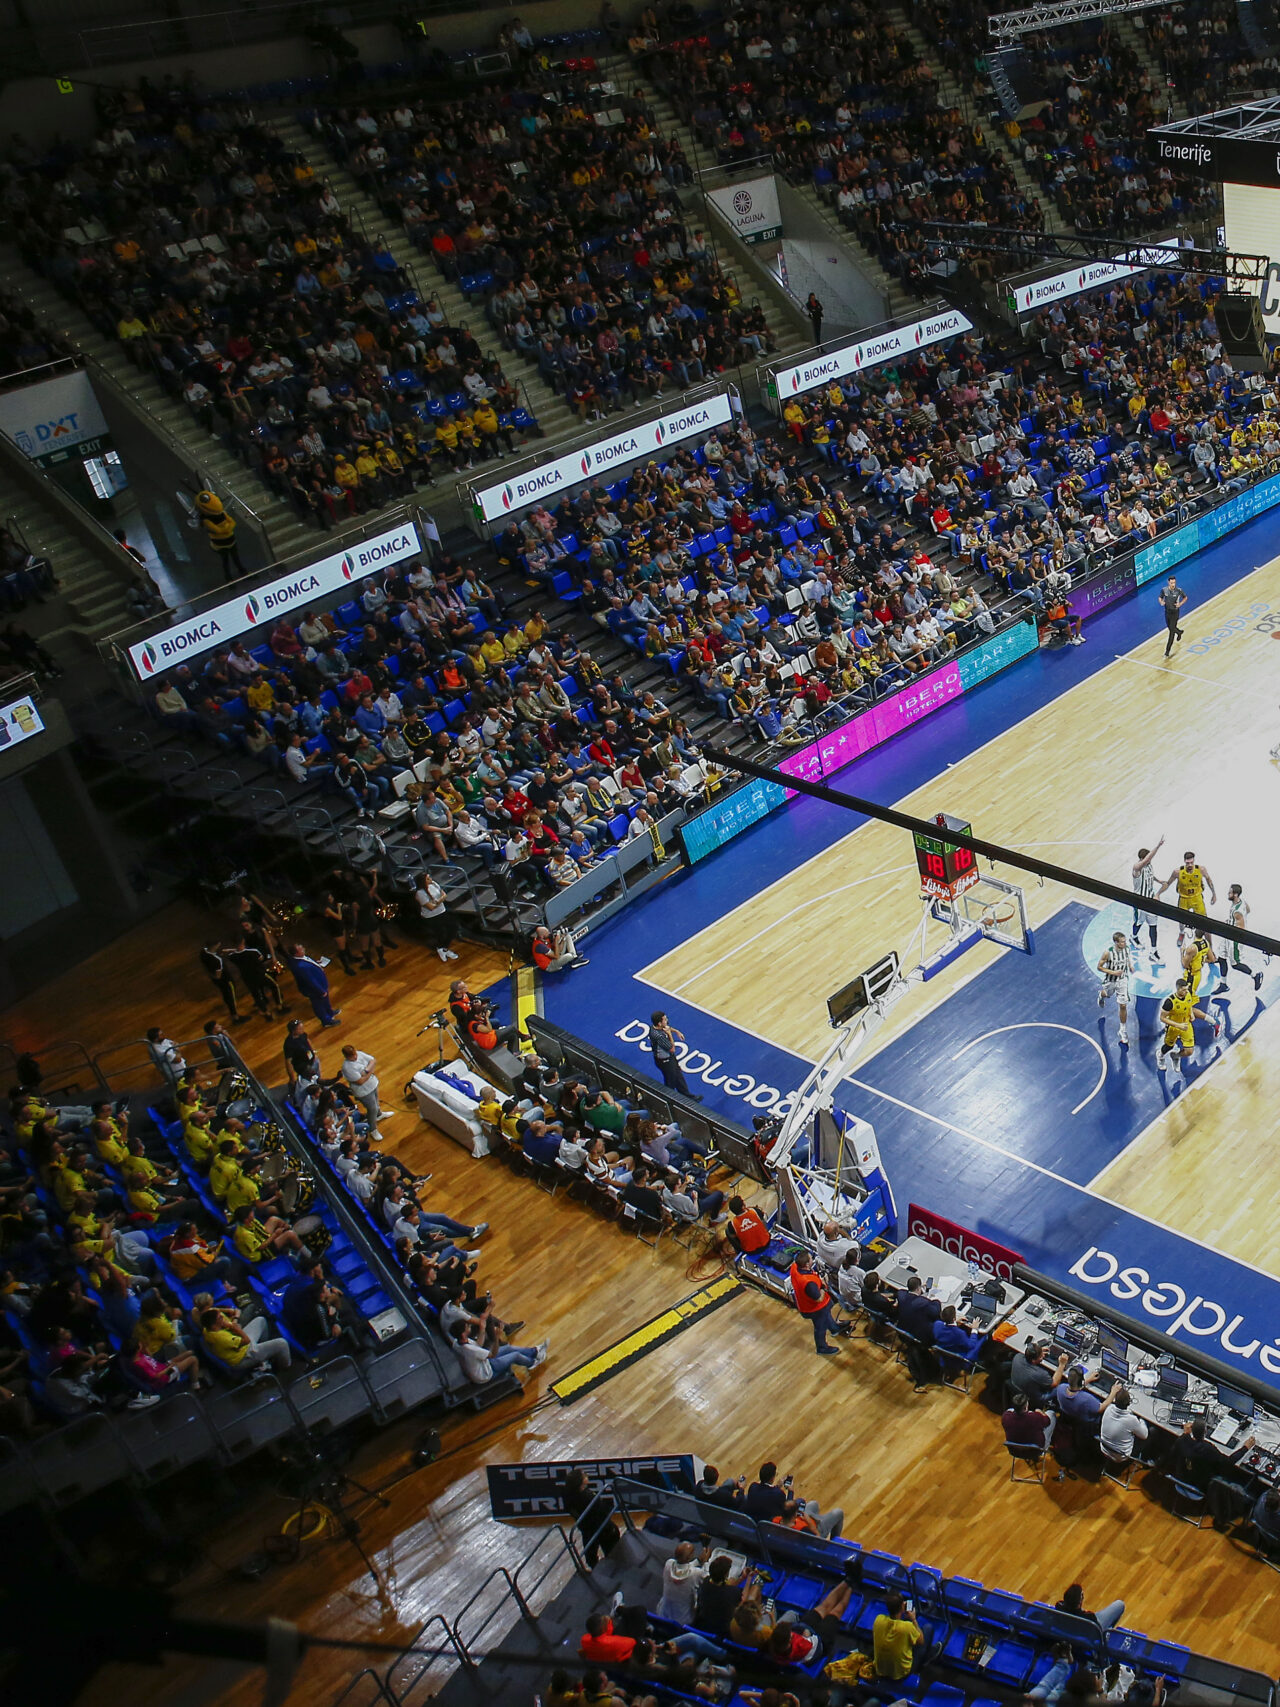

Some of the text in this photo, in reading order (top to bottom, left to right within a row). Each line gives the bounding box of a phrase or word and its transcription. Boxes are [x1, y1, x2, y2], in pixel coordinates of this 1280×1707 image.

[1158, 140, 1212, 165] Tenerife
[736, 213, 765, 226] LAGUNA
[763, 230, 776, 240] EXIT
[1088, 264, 1117, 280] BIOMCA
[1036, 281, 1066, 299] BIOMCA
[926, 317, 959, 337] BIOMCA
[867, 338, 901, 358] BIOMCA
[804, 360, 840, 382] BIOMCA
[35, 412, 79, 441] DXT
[669, 410, 710, 434] BIOMCA
[79, 440, 102, 455] EXIT
[595, 438, 638, 464] BIOMCA
[517, 469, 563, 497] BIOMCA
[358, 535, 411, 567] BIOMCA
[1087, 546, 1171, 602] IBEROSTAR
[264, 575, 320, 610] BIOMCA
[160, 620, 222, 657] BIOMCA
[1187, 603, 1270, 655] endesa
[899, 646, 1003, 713] IBEROSTAR
[926, 854, 944, 878] 18
[954, 848, 972, 871] 18
[922, 877, 950, 898] Libby's
[850, 1216, 871, 1239] DXT
[911, 1219, 1013, 1283] endesa
[500, 1460, 681, 1480] TENERIFE
